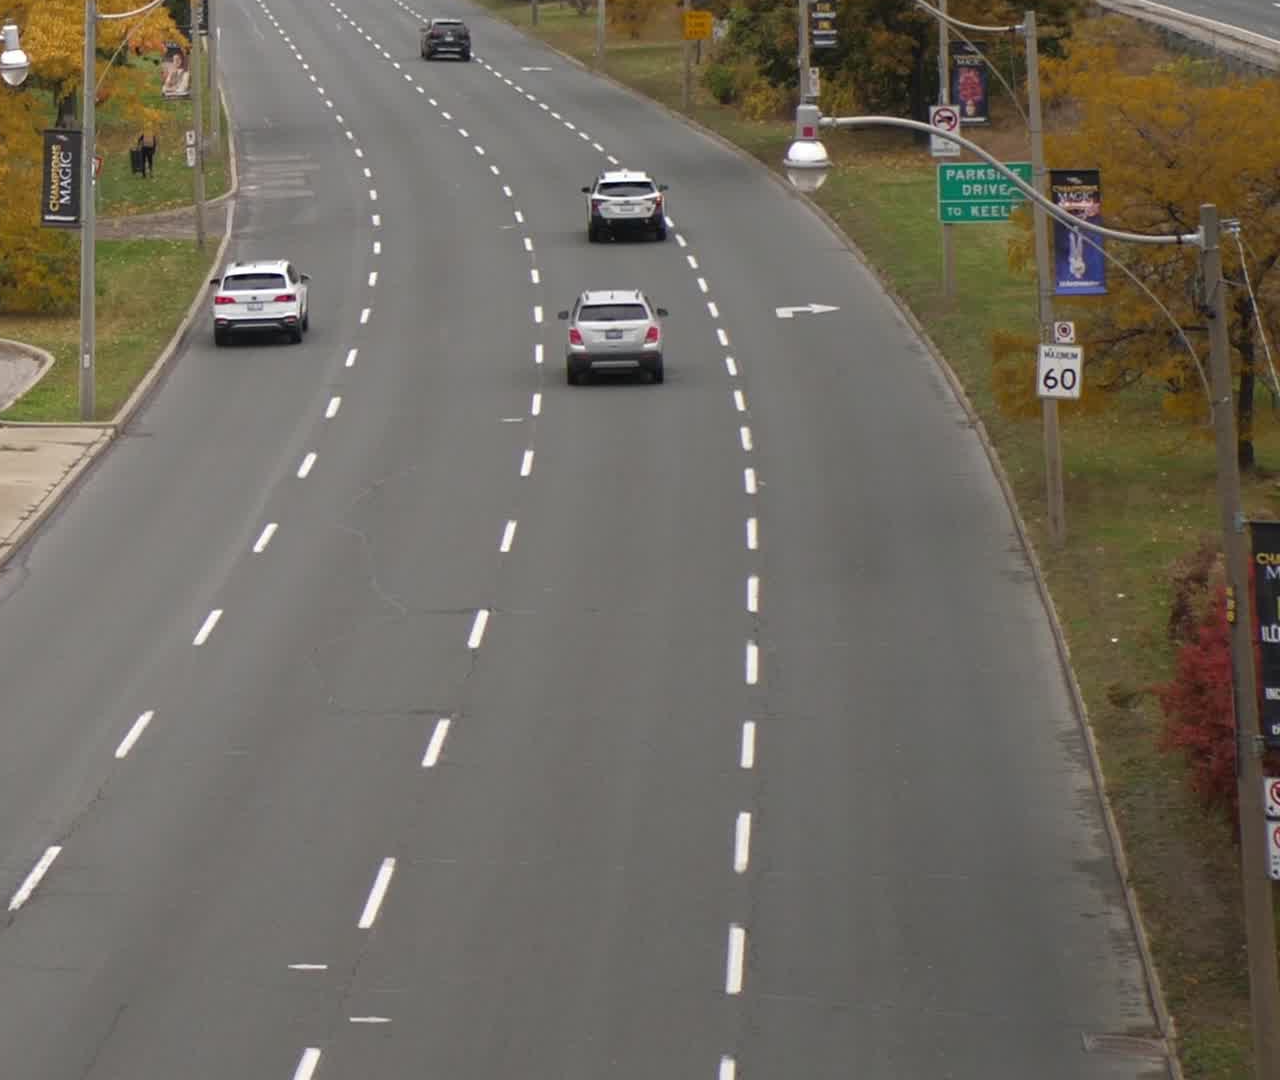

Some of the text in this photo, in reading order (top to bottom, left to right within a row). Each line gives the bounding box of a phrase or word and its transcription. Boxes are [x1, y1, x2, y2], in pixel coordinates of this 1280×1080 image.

[49, 144, 61, 212] CHAMPIONS
[60, 151, 72, 205] MAGIC
[946, 168, 1021, 181] PARKSI
[962, 184, 1008, 196] DRIVE
[947, 207, 962, 217] TO
[1043, 368, 1077, 391] 60
